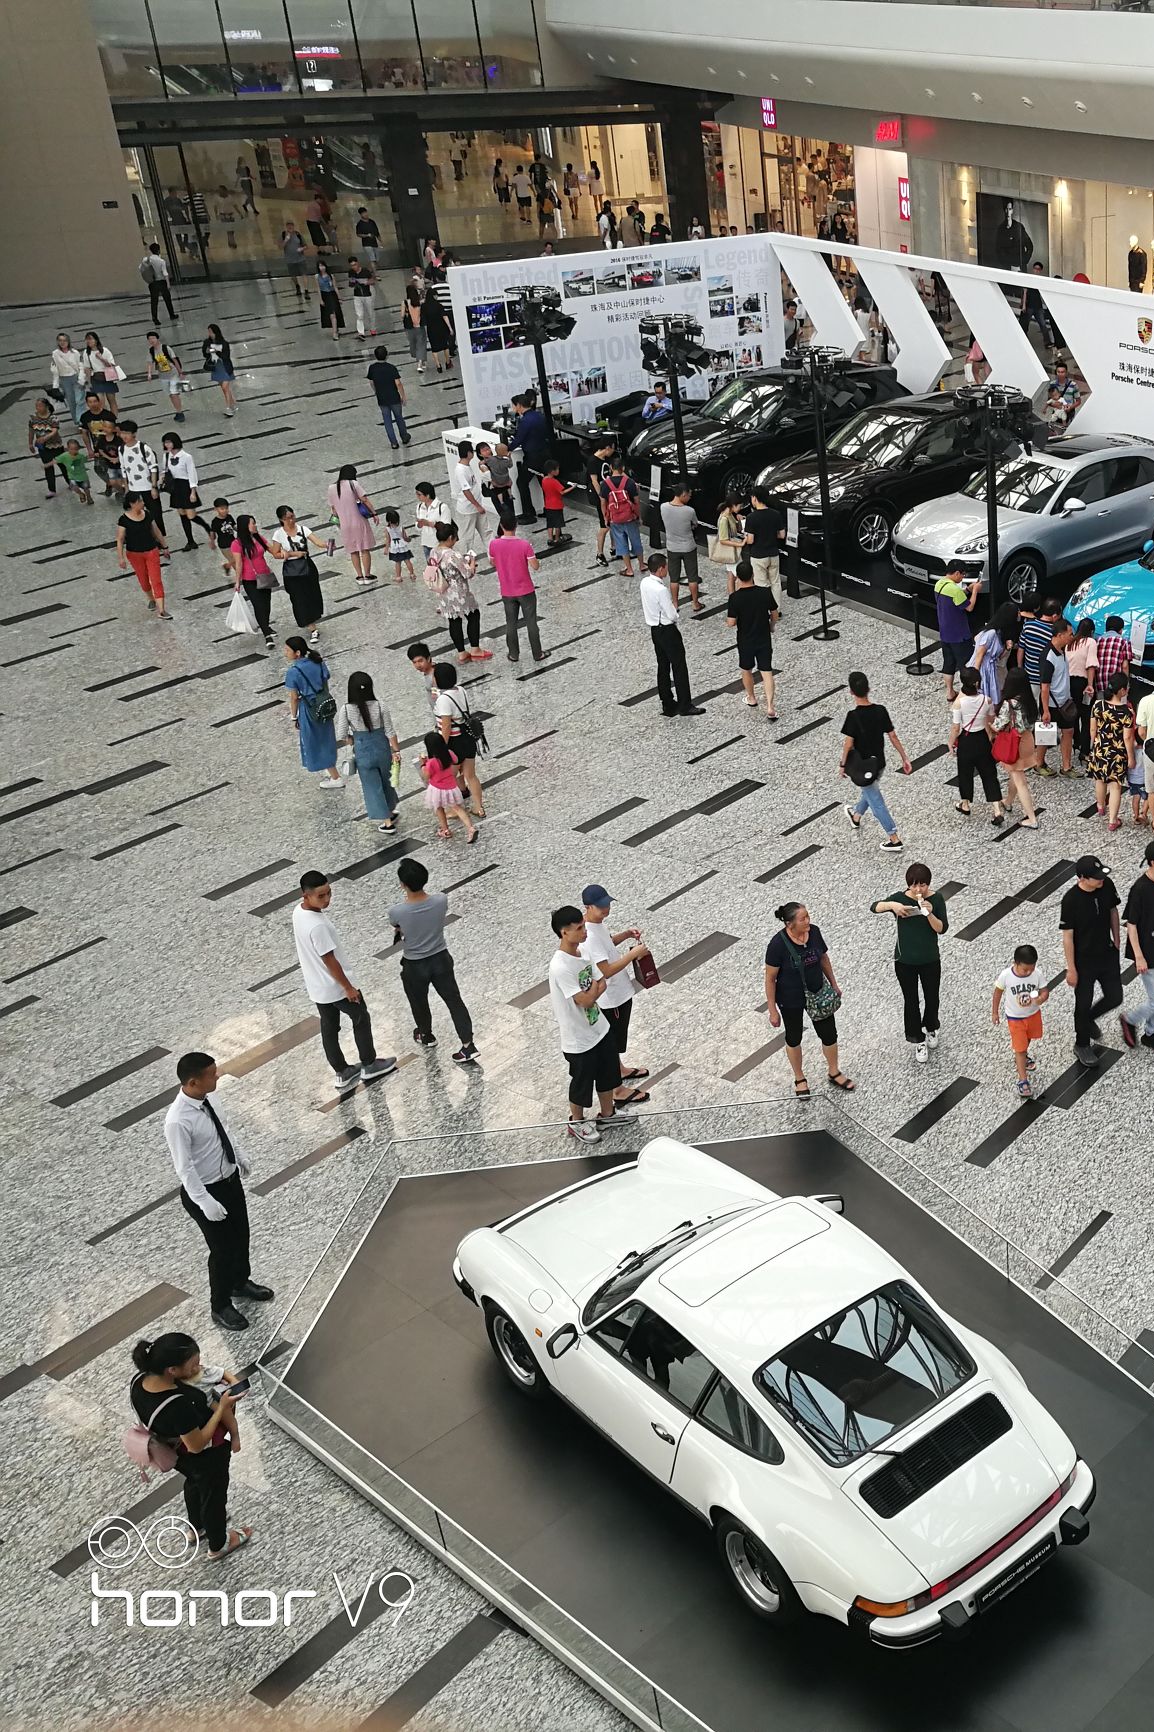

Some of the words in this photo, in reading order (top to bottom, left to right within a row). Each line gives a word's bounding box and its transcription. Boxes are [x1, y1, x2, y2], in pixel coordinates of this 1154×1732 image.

[762, 98, 773, 111] UNI
[763, 112, 775, 126] QLO
[704, 242, 768, 270] Legend
[461, 263, 559, 296] Inherited
[590, 295, 665, 312] 珠海及中山保时捷中心
[473, 334, 641, 384] FASCNATION
[1111, 371, 1134, 384] Porsche
[1136, 377, 1154, 388] Centre
[1010, 983, 1036, 995] BEAST
[982, 1564, 1026, 1602] PORSCHE
[1025, 1544, 1051, 1567] MUSEUM
